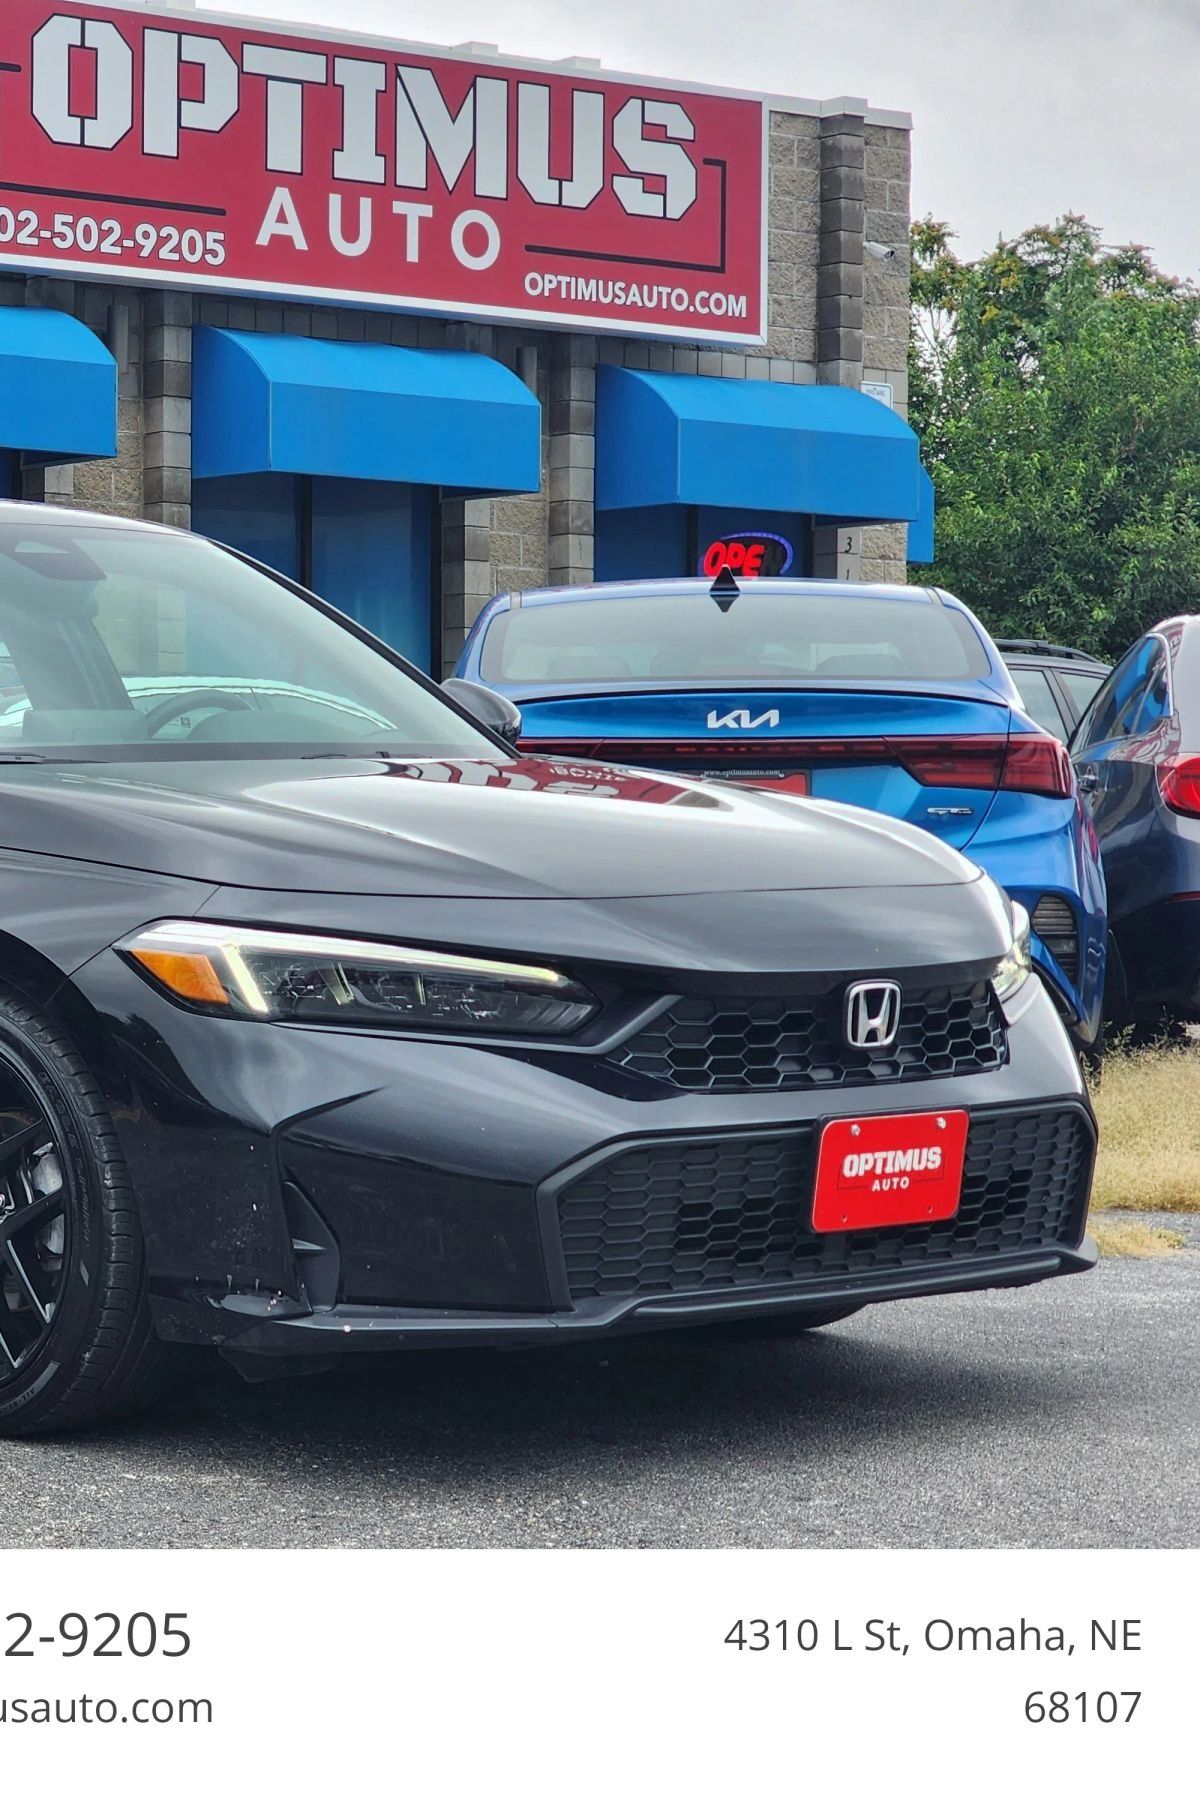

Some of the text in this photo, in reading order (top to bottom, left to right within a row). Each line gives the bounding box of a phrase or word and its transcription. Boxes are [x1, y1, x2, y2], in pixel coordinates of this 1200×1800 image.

[31, 12, 698, 221] OPTIMUS
[255, 187, 501, 271] AUTO
[524, 271, 747, 319] OPTIMUSAUTO.COM
[707, 709, 780, 729] KIA
[842, 1146, 942, 1178] OPTIMUS
[872, 1176, 910, 1192] AUTO
